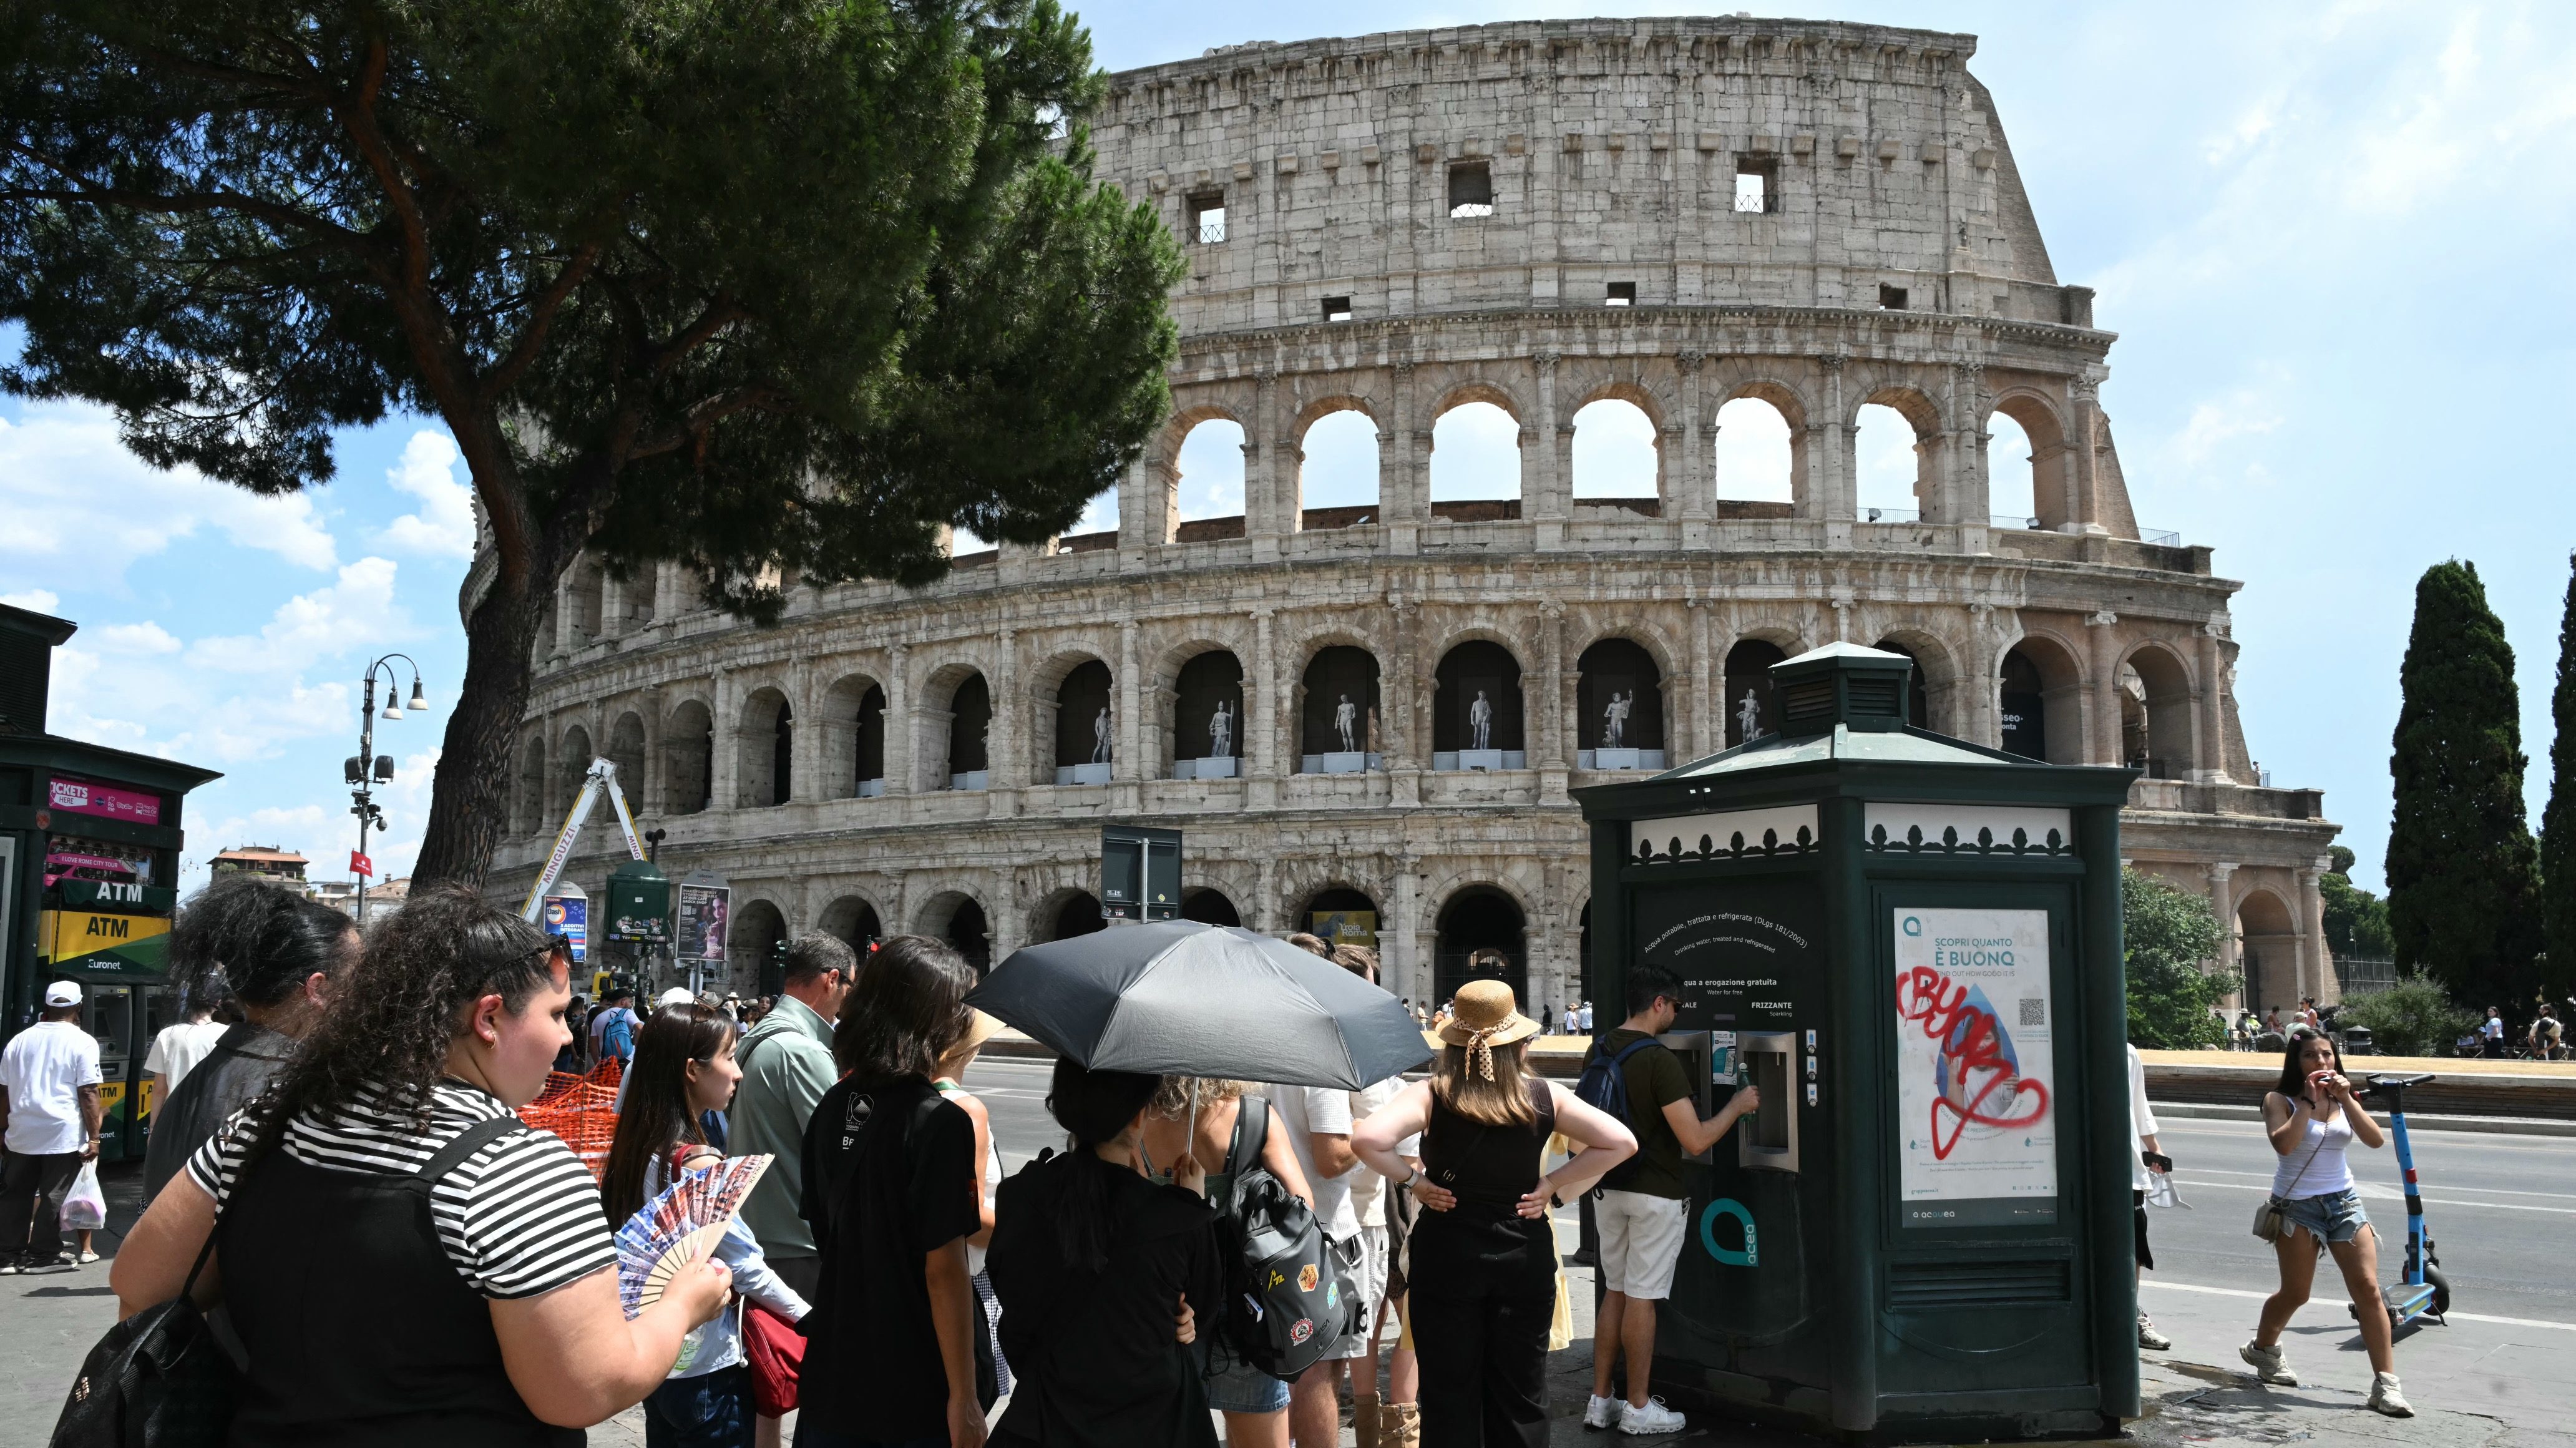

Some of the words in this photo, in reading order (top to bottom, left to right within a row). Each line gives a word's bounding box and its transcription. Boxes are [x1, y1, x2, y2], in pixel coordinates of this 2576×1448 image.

[59, 796, 74, 805] HERE
[543, 828, 576, 884] MINGUZZI
[628, 835, 642, 859] MING
[97, 881, 142, 903] ATM
[86, 916, 129, 938] ATM
[1644, 937, 1661, 953] Acqua
[1661, 923, 1686, 941] potabile,
[1687, 915, 1710, 926] trattata
[1719, 912, 1752, 921] refrigerata
[1754, 916, 1773, 928] (DLgs
[1775, 924, 1807, 949] 181/2003)
[1674, 942, 1695, 956] Drinking
[1745, 939, 1776, 953] refrigerated
[1934, 938, 1969, 947] SCOPRI
[1972, 938, 2012, 947] QUANTO
[89, 959, 120, 971] Euronet
[1935, 947, 1944, 966] È
[1747, 979, 1777, 987] gratuita
[99, 1131, 115, 1139] ronet
[1746, 1225, 1756, 1264] acea
[1314, 1318, 1330, 1340] NASA
